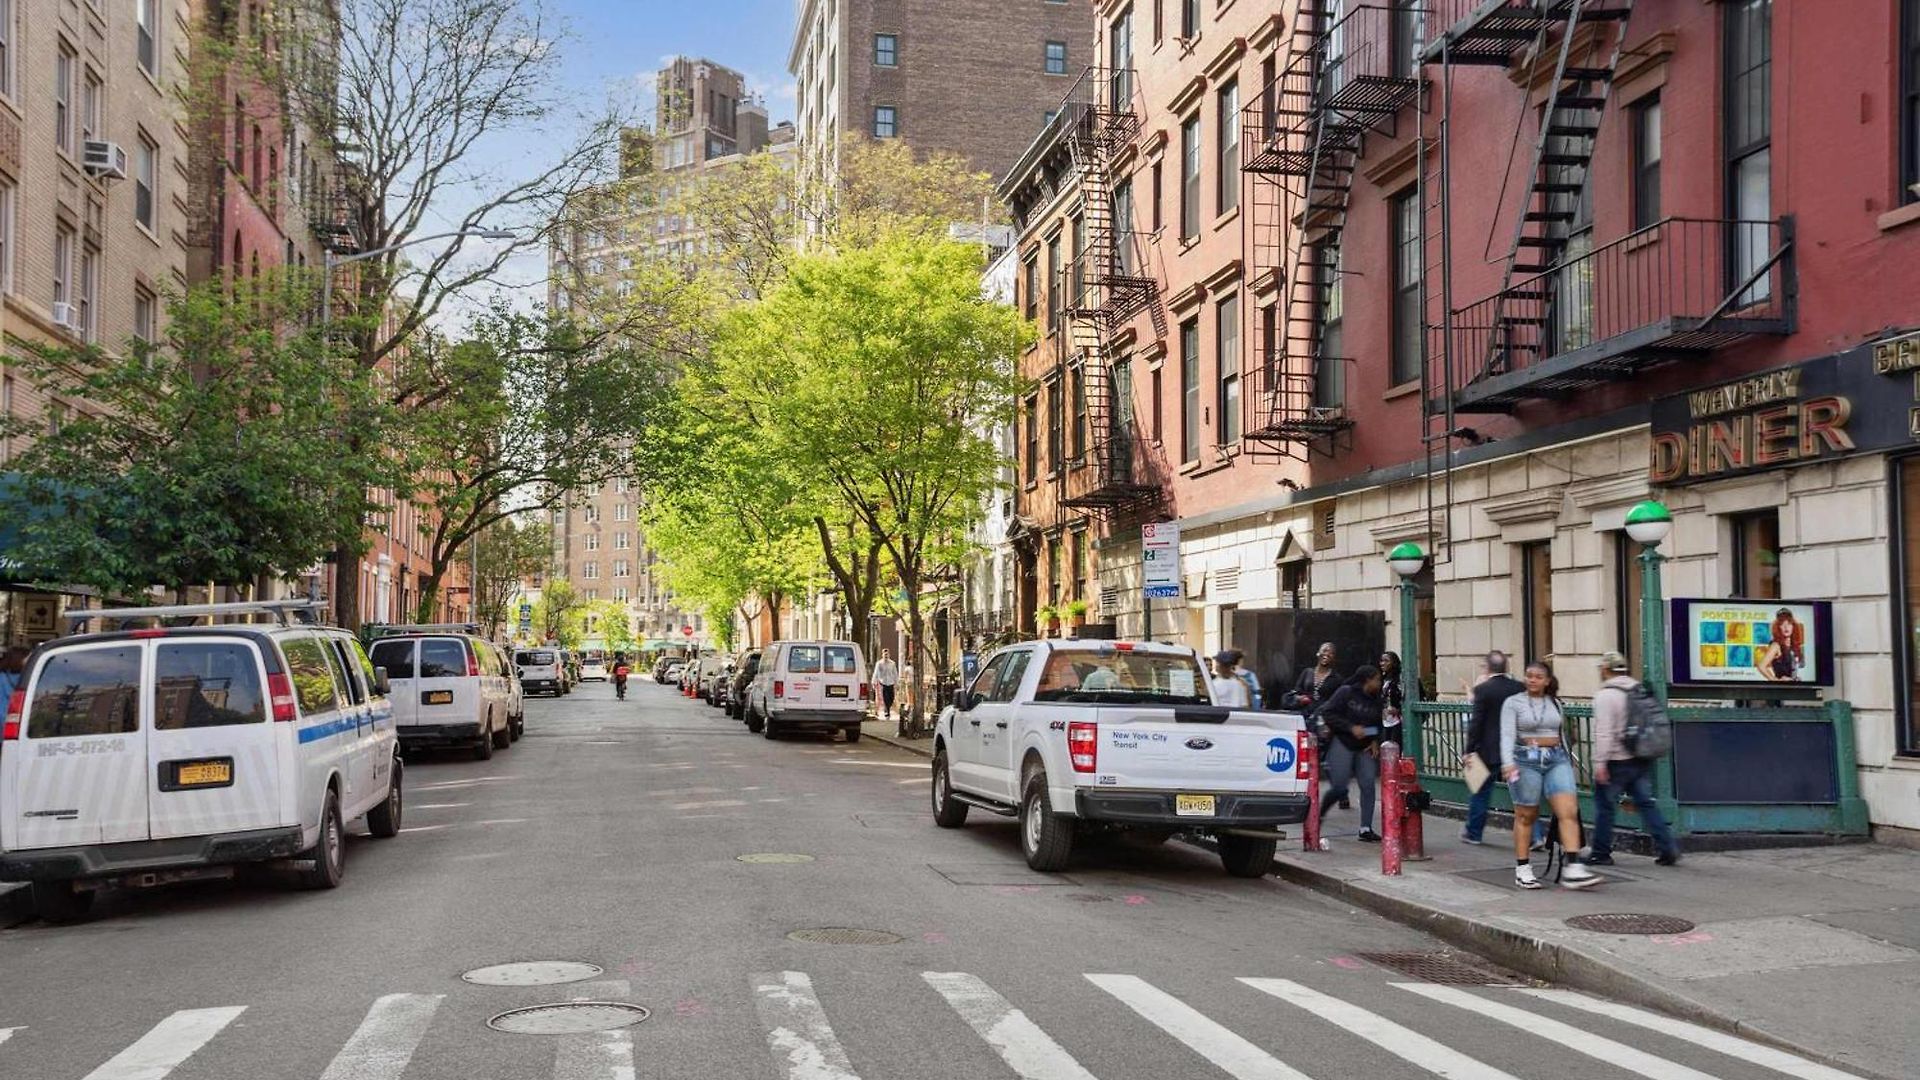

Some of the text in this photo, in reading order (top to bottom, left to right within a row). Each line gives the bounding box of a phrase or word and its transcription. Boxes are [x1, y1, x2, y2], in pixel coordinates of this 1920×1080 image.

[1874, 338, 1920, 375] BR
[1689, 369, 1800, 417] WAVERLY
[1651, 396, 1855, 482] DINER
[1113, 731, 1168, 743] New York City
[1113, 740, 1137, 749] Transit
[1266, 744, 1291, 765] MTA
